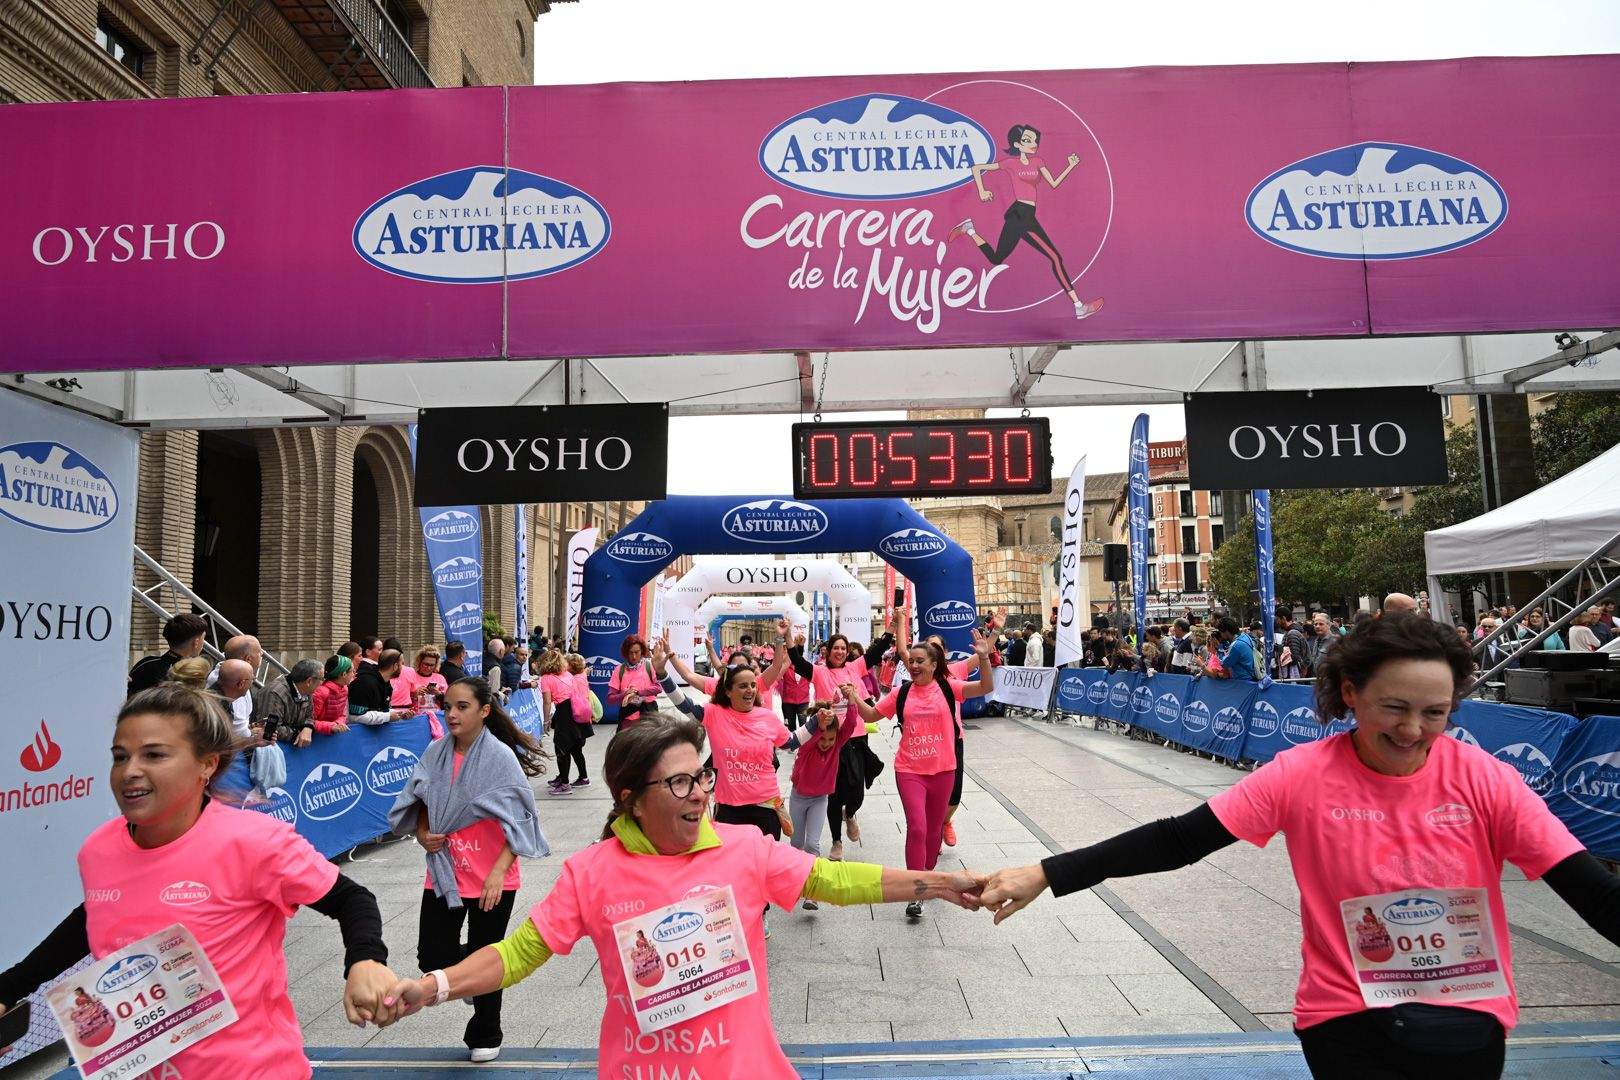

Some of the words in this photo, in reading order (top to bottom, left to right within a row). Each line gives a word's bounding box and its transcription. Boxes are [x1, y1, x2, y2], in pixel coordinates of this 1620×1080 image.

[813, 130, 888, 141] CENTRAL
[894, 128, 969, 140] LECHERA
[777, 134, 976, 173] ASTURIANA
[1305, 183, 1385, 196] CENTRAL
[1394, 180, 1478, 193] LECHERA
[413, 206, 493, 220] CENTRAL
[500, 203, 583, 217] LECHERA
[1267, 188, 1490, 231] ASTURIANA
[740, 194, 935, 249] Carrera
[32, 221, 225, 265] OYSHO
[373, 212, 591, 255] ASTURIANA
[788, 251, 825, 290] de
[833, 251, 859, 290] la
[853, 241, 1010, 335] Mujer
[1228, 421, 1408, 460] OYSHO
[457, 436, 632, 473] OYSHO
[1150, 447, 1182, 459] TIBUR
[15, 464, 60, 482] CENTRAL
[64, 476, 107, 493] LECHERA
[730, 513, 820, 532] ASTURIANA
[1156, 496, 1164, 538] HOTEL
[610, 543, 667, 556] ASTURIANA
[885, 541, 943, 552] ASTURIANA
[1060, 488, 1081, 627] OYSHO
[726, 566, 808, 584] OYSHO
[0, 601, 112, 642] YSHO
[583, 615, 626, 627] ASTURIANA
[928, 612, 974, 623] ASTURIANA
[1003, 670, 1043, 690] OYSHO
[1284, 718, 1318, 739] ASTURIANA
[908, 733, 944, 746] DORSAL
[724, 748, 738, 758] TU
[909, 747, 937, 757] SUMA
[371, 764, 413, 789] ASTURIAN
[726, 761, 764, 772] DORSAL
[727, 772, 760, 783] SUMA
[305, 781, 360, 813] ASTURIANA
[1331, 807, 1384, 824] OYSHO
[87, 888, 121, 902] OYSHO
[162, 889, 207, 901] ASTURIANA
[601, 899, 645, 917] OYSHO
[1387, 907, 1441, 921] ASTURIANA
[657, 917, 701, 940] ASTURIANA
[1397, 932, 1446, 952] 016
[665, 941, 706, 969] 016
[1411, 955, 1442, 967] 5063
[103, 960, 155, 991] ASTURIANA
[678, 964, 704, 981] 5064
[1372, 972, 1411, 980] CARRERA
[1439, 967, 1465, 977] MUJER
[647, 989, 681, 1006] CARRERA
[681, 985, 692, 994] DE
[692, 981, 701, 989] LA
[701, 972, 724, 986] MUJER
[712, 980, 748, 999] Santander
[1374, 988, 1417, 999] OYSHO
[1451, 980, 1495, 993] Santander
[116, 983, 166, 1019] 016
[134, 1006, 166, 1030] 5065
[648, 1004, 686, 1024] OYSHO
[181, 1010, 224, 1039] Santander
[97, 1039, 139, 1066] CARRERA
[140, 1031, 151, 1041] DE
[153, 1025, 164, 1036] LA
[165, 1009, 193, 1028] MUJER
[624, 1021, 731, 1055] DORSAL
[101, 1053, 147, 1080] OYSHO
